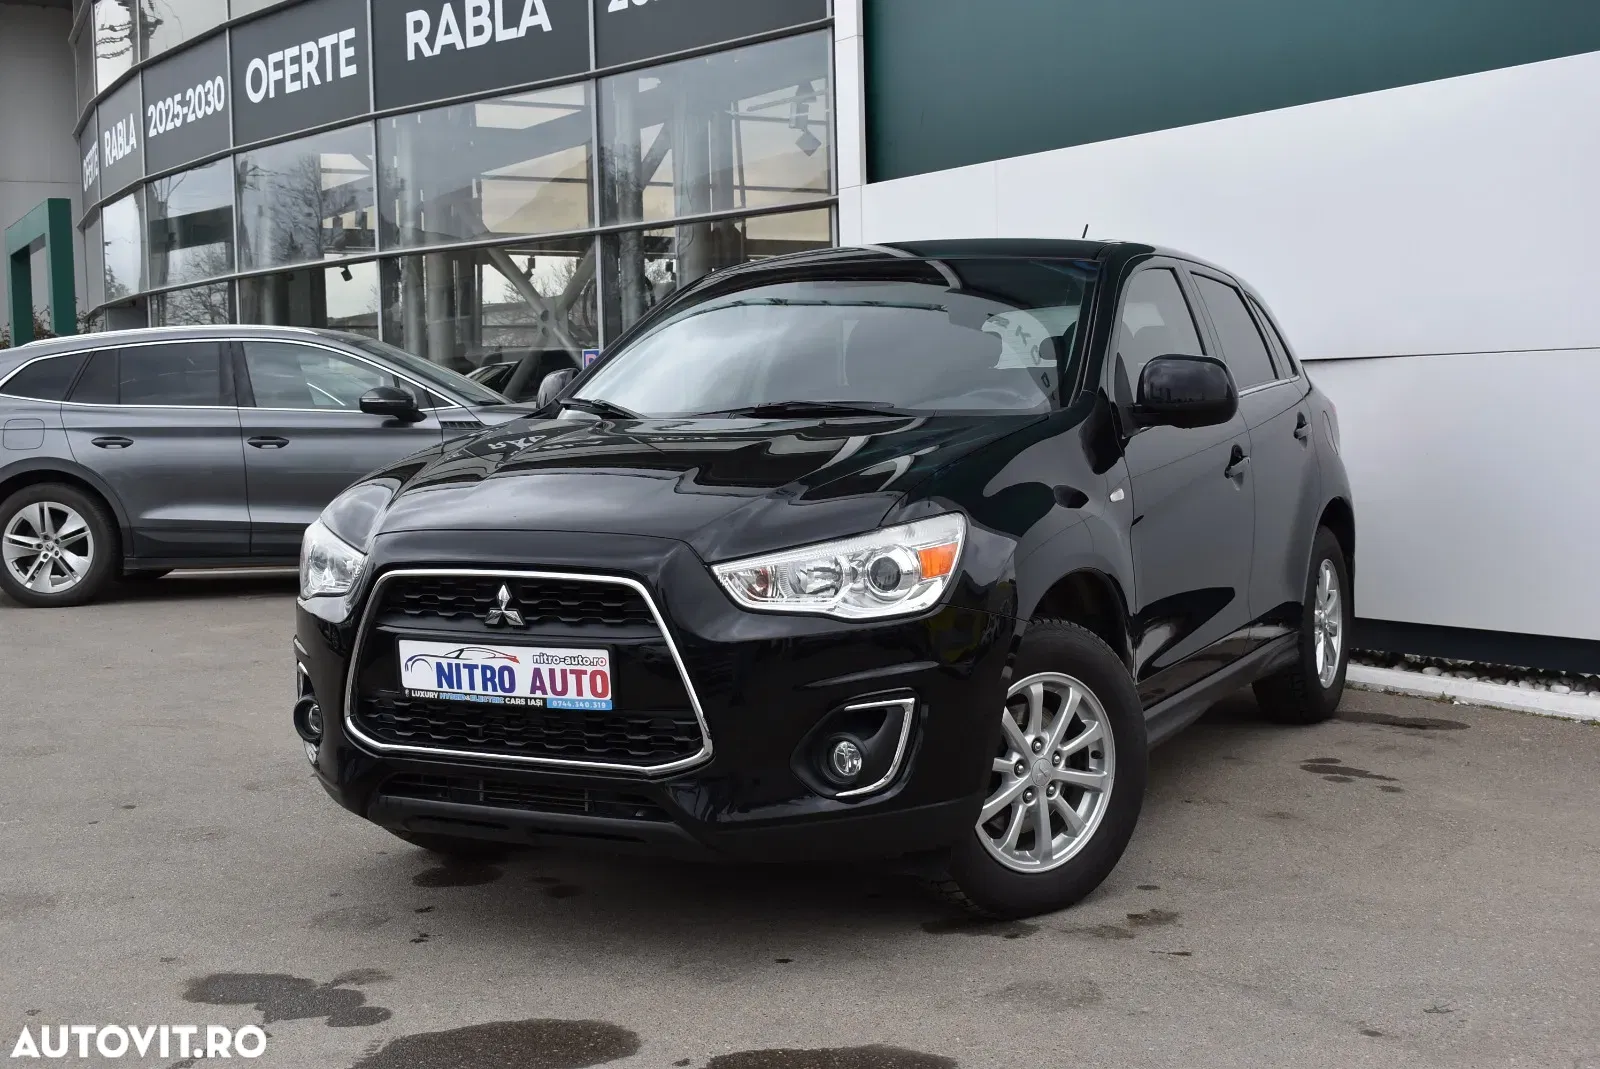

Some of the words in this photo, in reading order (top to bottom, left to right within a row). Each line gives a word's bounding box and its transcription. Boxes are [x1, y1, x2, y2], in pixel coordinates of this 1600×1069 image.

[104, 113, 137, 167] RABLA
[147, 75, 225, 137] 2025-2030
[245, 27, 357, 103] OFERTE
[406, 0, 552, 61] RABLA
[532, 652, 607, 667] nitro-auto.ro
[436, 661, 516, 694] NITRO
[529, 667, 610, 699] AUTO
[411, 689, 438, 699] LUXURY
[505, 697, 526, 706] CARS
